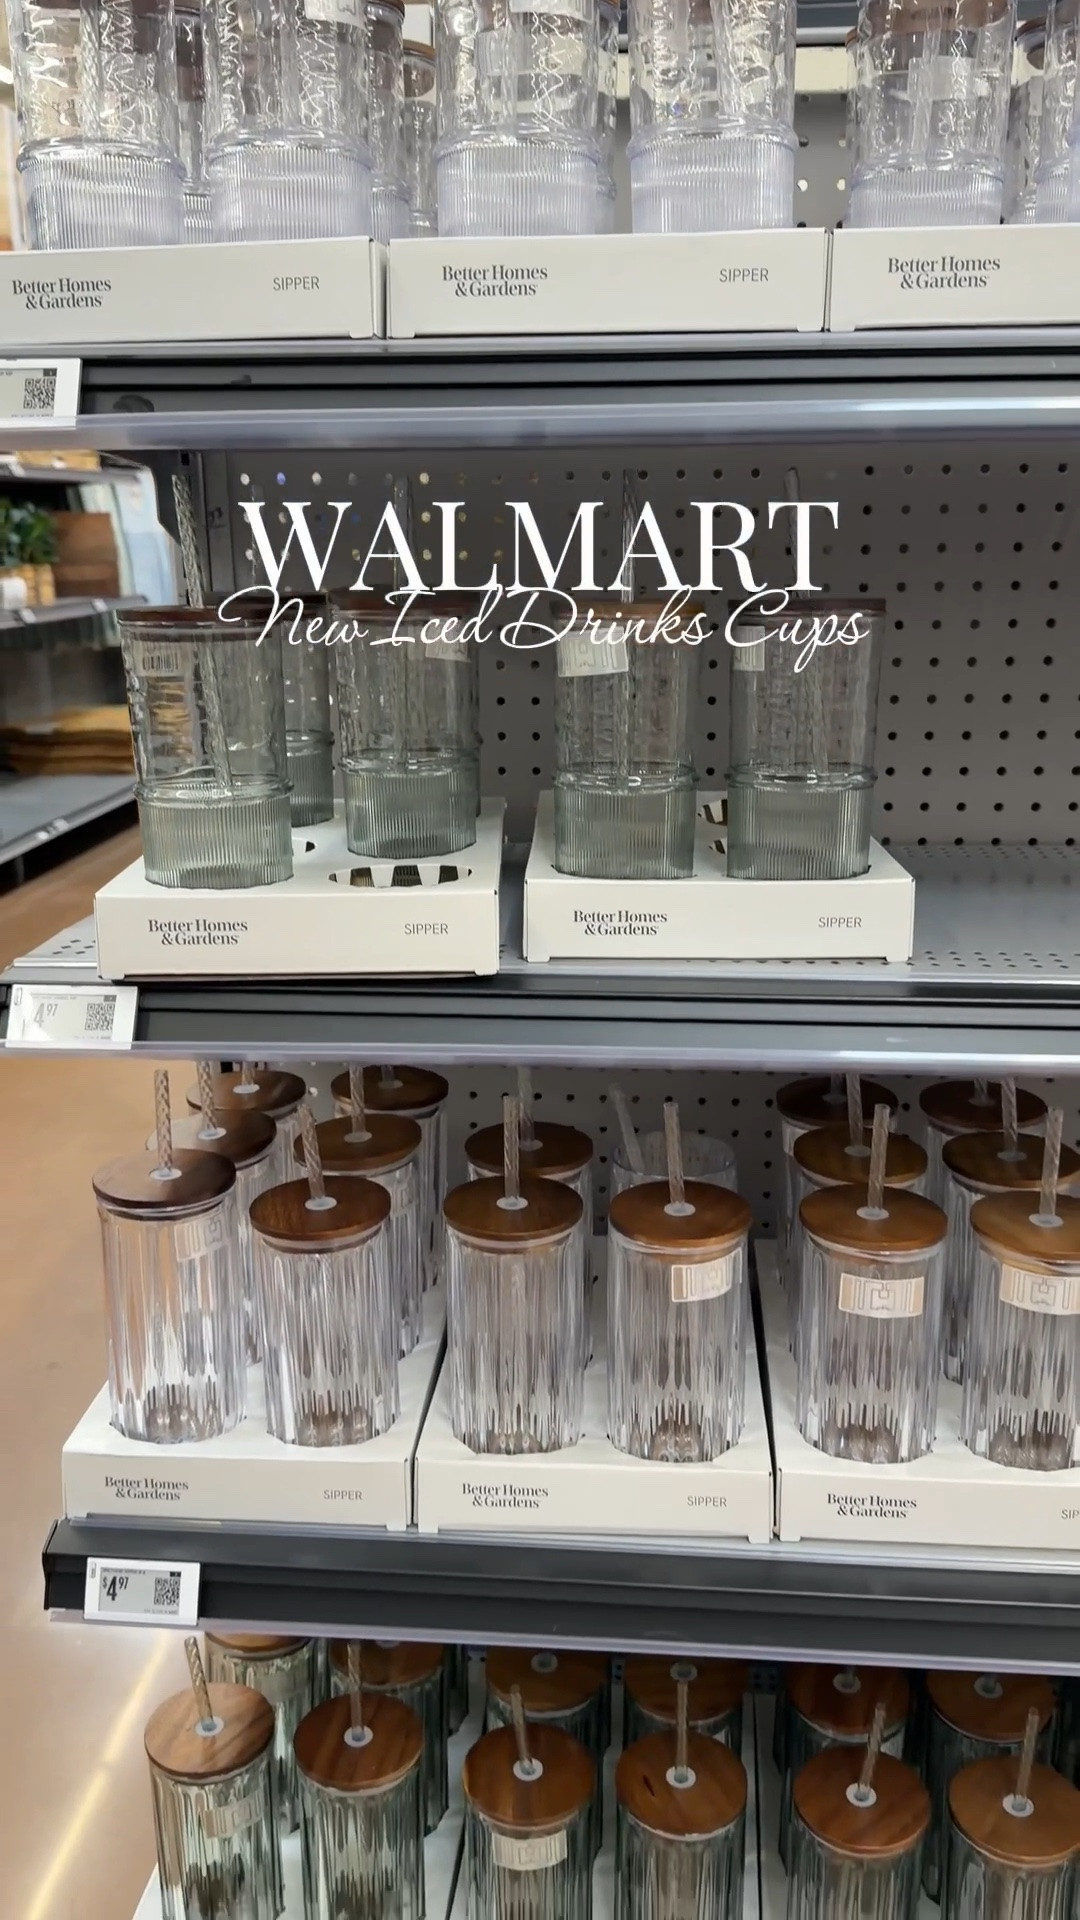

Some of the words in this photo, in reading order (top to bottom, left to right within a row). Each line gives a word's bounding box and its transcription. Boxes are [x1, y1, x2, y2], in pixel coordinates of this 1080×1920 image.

[888, 257, 938, 274] Better
[941, 256, 1001, 272] Homes
[442, 265, 489, 282] Better
[492, 264, 548, 280] Homes
[719, 268, 769, 283] SIPPER
[12, 278, 56, 295] Better
[59, 277, 112, 293] Homes
[272, 276, 320, 291] SIPPER
[574, 909, 615, 923] Better
[617, 909, 668, 923] Homes
[818, 916, 862, 928] SIPPER
[148, 918, 192, 933] Better
[194, 918, 248, 932] Homes
[404, 922, 449, 936] SIPPER
[104, 1476, 142, 1490] Better
[144, 1478, 189, 1492] Homes
[462, 1482, 501, 1496] Better
[503, 1484, 549, 1498] Homes
[323, 1489, 363, 1501] SIPPER
[687, 1495, 727, 1508] SIPPER
[827, 1493, 868, 1507] Better
[870, 1495, 918, 1509] Homes
